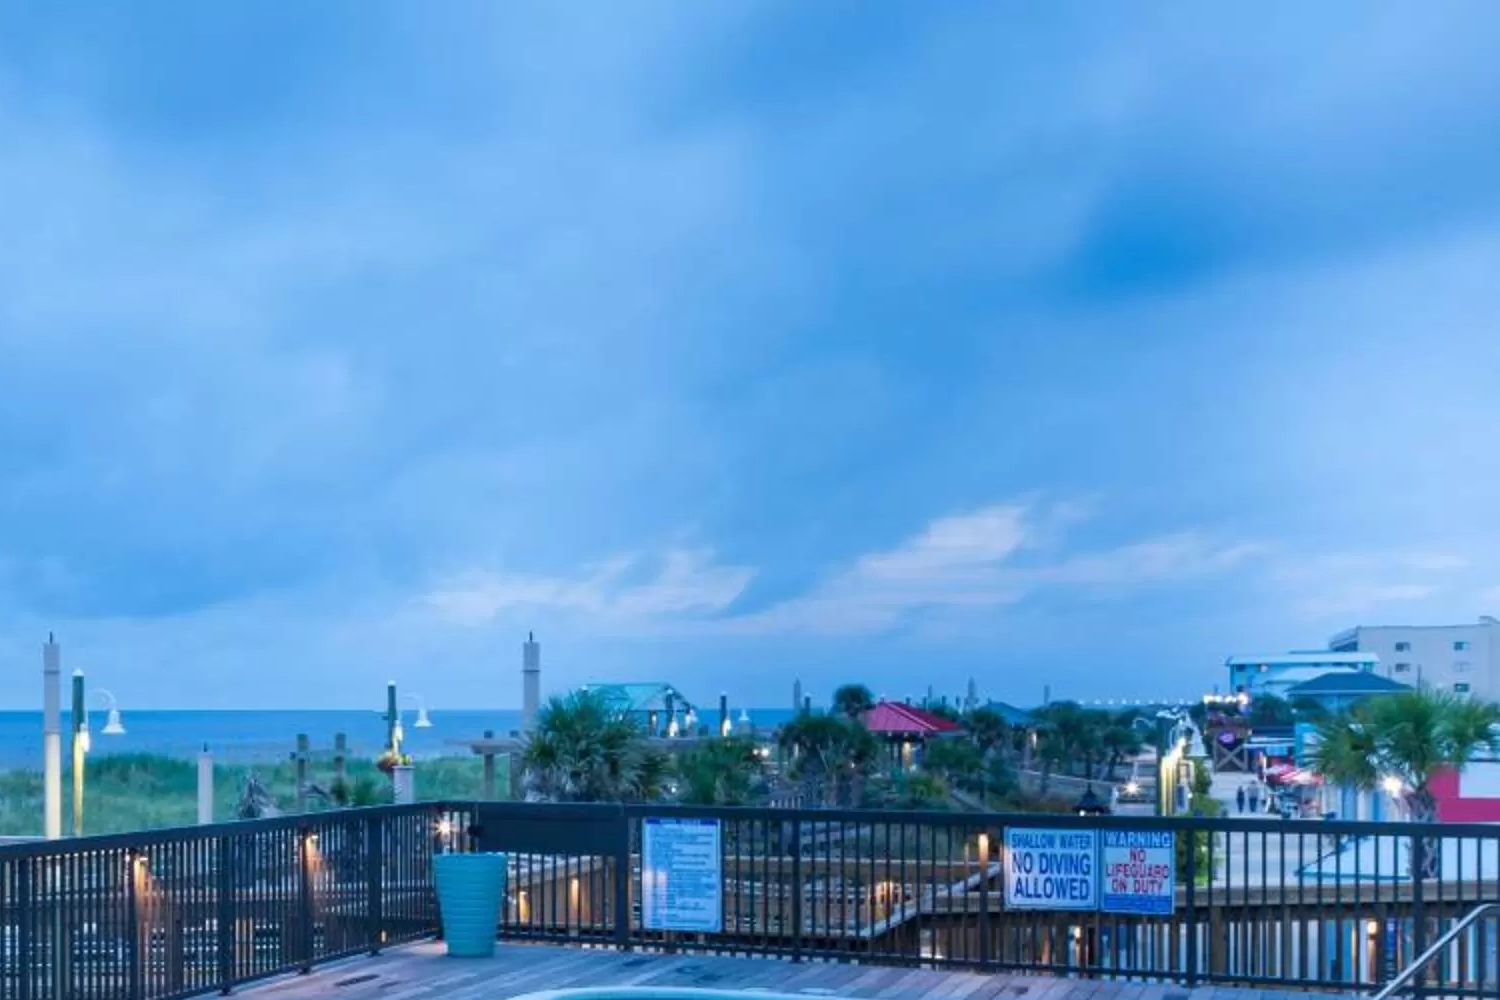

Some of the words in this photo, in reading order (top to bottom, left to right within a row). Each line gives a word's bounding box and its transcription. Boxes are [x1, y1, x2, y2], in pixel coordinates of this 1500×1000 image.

[1105, 831, 1170, 848] WARNING
[1129, 848, 1146, 863] NO
[1012, 852, 1033, 874] NO
[1039, 852, 1091, 876] DIVING
[1106, 864, 1169, 879] LIFEGUARD
[1014, 876, 1090, 901] ALLOWED
[1134, 880, 1163, 893] DUTY
